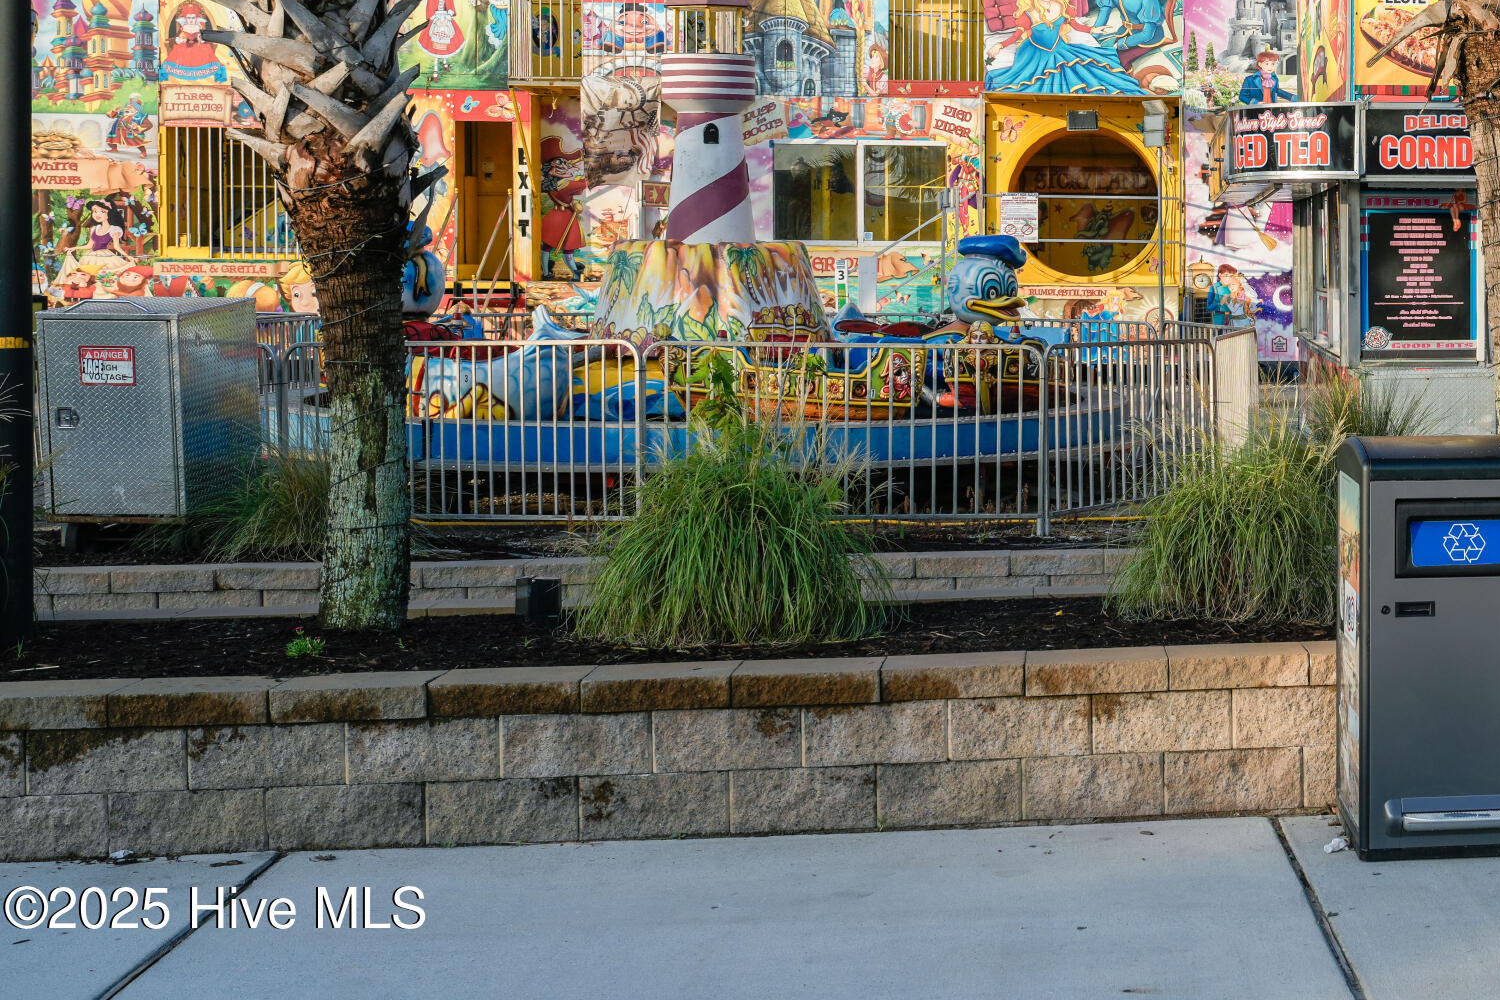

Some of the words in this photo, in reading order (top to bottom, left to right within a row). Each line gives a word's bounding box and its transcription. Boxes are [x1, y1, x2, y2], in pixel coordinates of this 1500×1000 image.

[174, 92, 213, 100] THREE
[164, 103, 199, 112] LITTLE
[200, 103, 223, 112] PIGS
[743, 102, 777, 123] PUSS
[943, 104, 973, 123] PIED
[742, 118, 783, 140] BOOTS
[933, 118, 972, 138] PIPER
[1259, 110, 1286, 133] Style
[1286, 109, 1327, 131] Sweet
[1404, 114, 1468, 132] DELICI
[1274, 131, 1330, 167] TEA
[1379, 134, 1474, 170] CORND
[517, 147, 530, 237] EXIT
[645, 185, 668, 204] EX
[1366, 197, 1439, 207] MENU
[160, 264, 208, 274] HANSEL
[209, 264, 218, 274] &
[221, 264, 267, 274] GRETLE
[837, 270, 845, 281] 3
[1436, 341, 1474, 349] EATS
[88, 373, 127, 381] VOLTAGE
